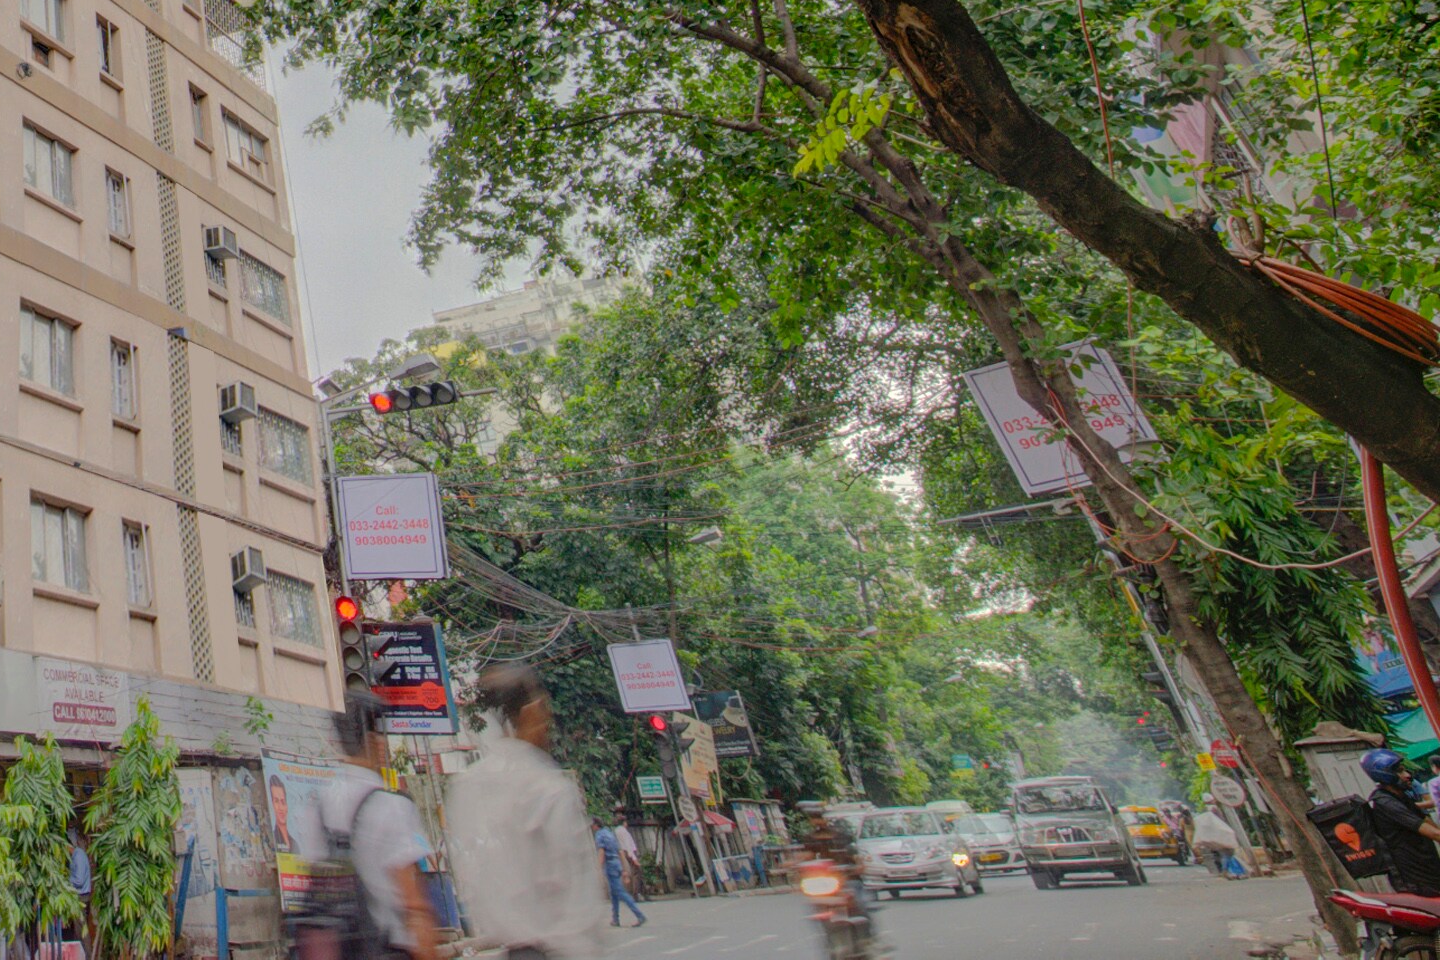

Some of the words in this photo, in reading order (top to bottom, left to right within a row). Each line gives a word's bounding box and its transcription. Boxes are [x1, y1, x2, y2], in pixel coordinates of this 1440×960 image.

[376, 505, 399, 516] Call:
[350, 518, 429, 531] 033-2442-3448
[355, 534, 427, 546] 9038004949
[54, 704, 75, 719] CALL
